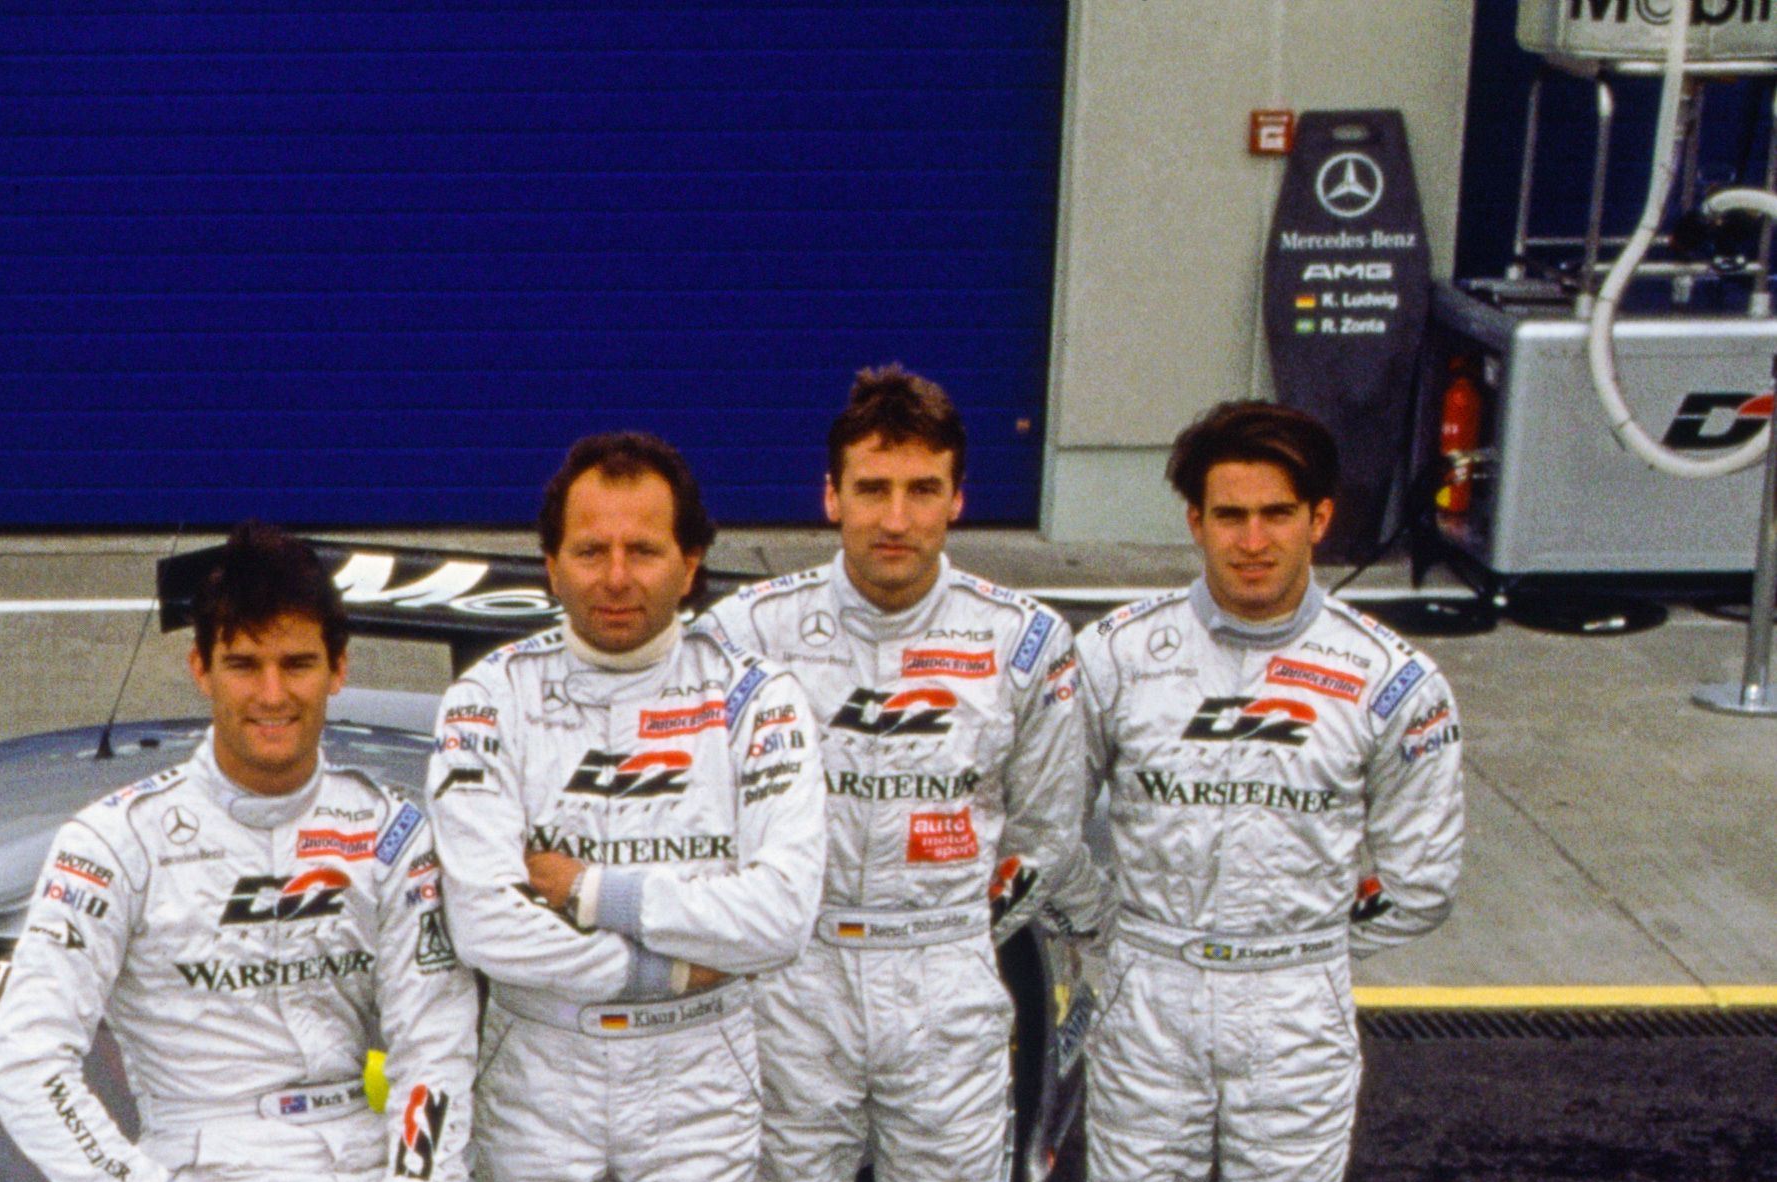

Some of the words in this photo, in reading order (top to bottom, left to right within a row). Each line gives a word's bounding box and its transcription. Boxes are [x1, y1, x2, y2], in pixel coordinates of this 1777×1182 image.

[1280, 230, 1417, 250] Mercedes-Benz
[1302, 262, 1393, 282] AMG
[1342, 292, 1398, 310] Ludwig
[1340, 317, 1387, 334] Zonta
[925, 628, 994, 642] AMG
[1301, 641, 1372, 670] AMG
[829, 686, 959, 738] D2
[1181, 697, 1318, 746] D2
[749, 732, 785, 758] obil
[562, 749, 694, 799] D2
[1135, 771, 1337, 814] WARSTEINER
[314, 806, 375, 822] AMG
[219, 867, 352, 926] D2
[633, 1009, 676, 1028] Klaus
